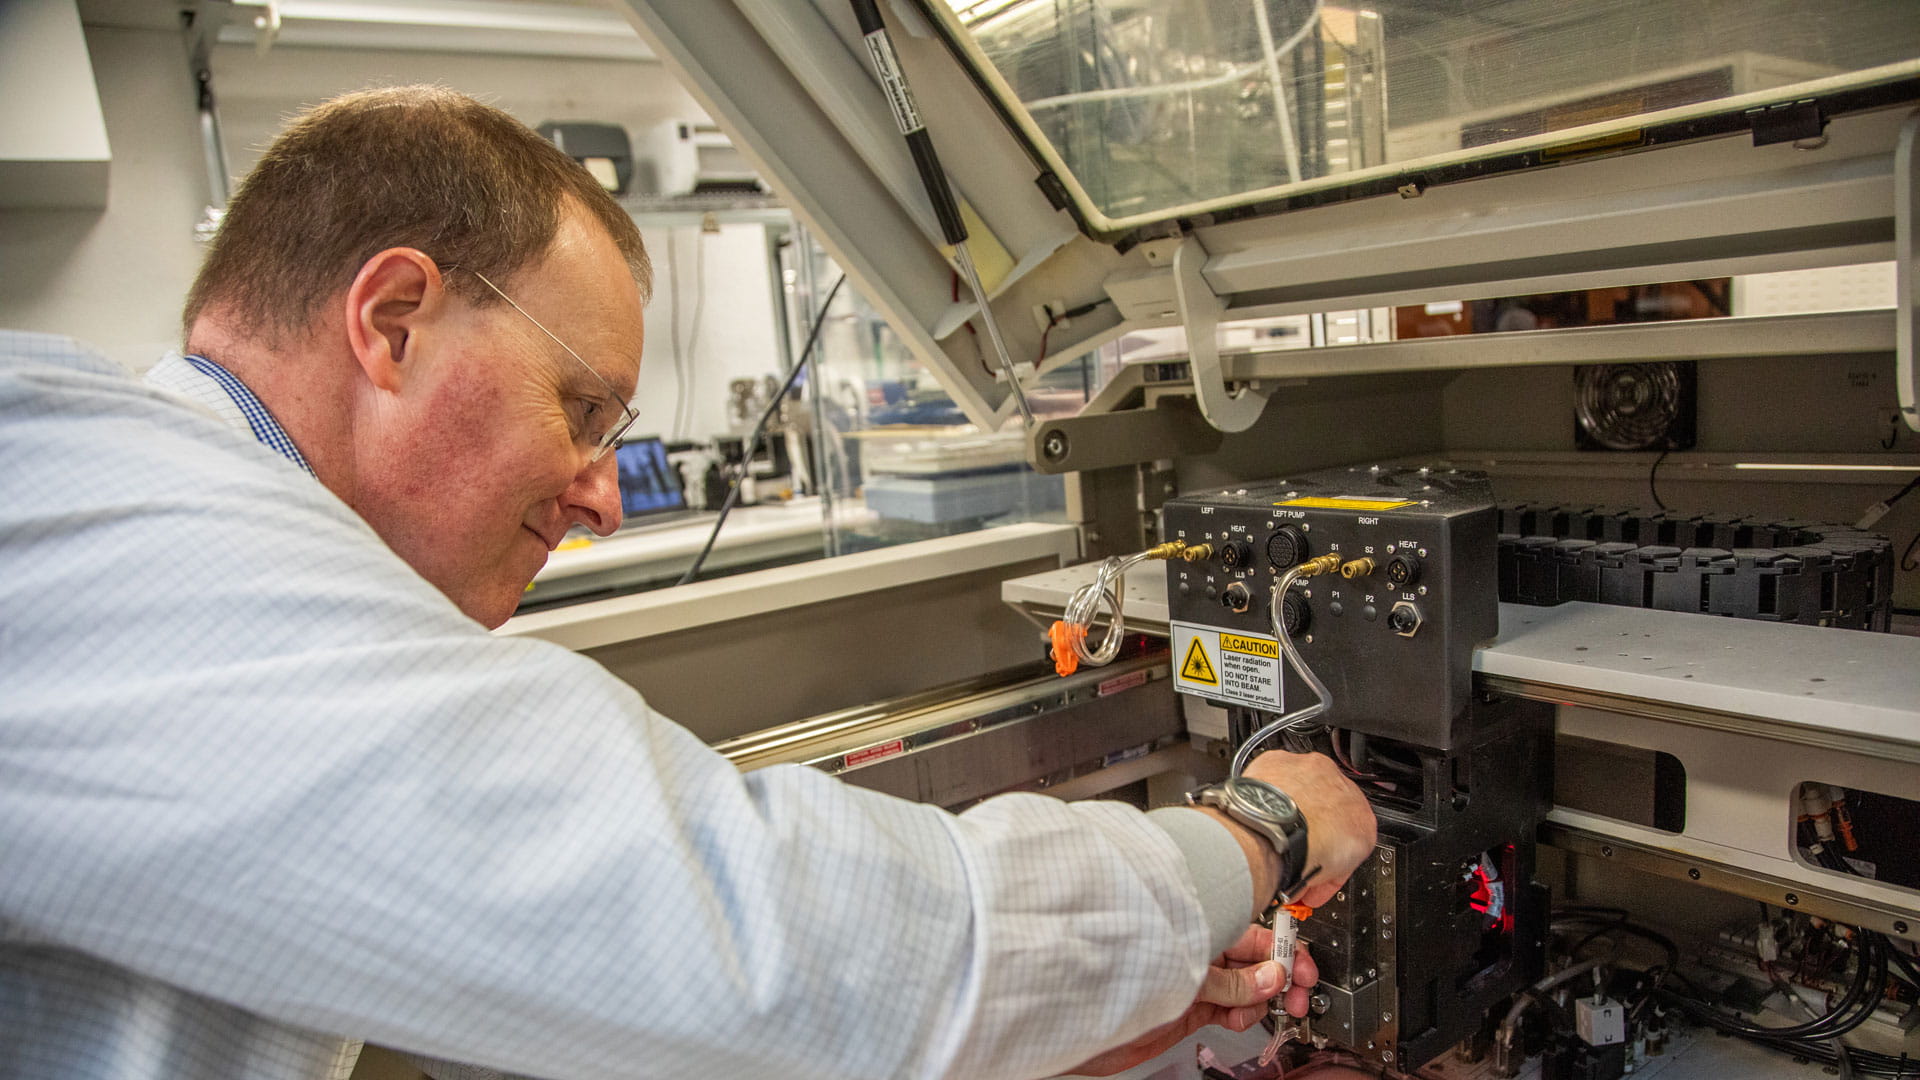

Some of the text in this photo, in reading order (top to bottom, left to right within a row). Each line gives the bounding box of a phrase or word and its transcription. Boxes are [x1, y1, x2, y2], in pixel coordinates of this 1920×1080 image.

[1201, 507, 1214, 515] LEFT
[1273, 510, 1306, 519] LEFT PUMP
[1358, 517, 1379, 525] RIGHT
[1231, 525, 1246, 533] HEAT
[1205, 532, 1212, 540] S4
[1399, 540, 1418, 549] HEAT
[1180, 572, 1187, 580] P3
[1207, 575, 1214, 583] P4
[1235, 571, 1246, 579] LLS
[1402, 592, 1415, 600] LLS
[1232, 639, 1276, 655] CAUTION
[1224, 654, 1271, 667] Laser radiation
[1224, 662, 1260, 673] when open.
[1235, 672, 1249, 681] NOT
[1250, 674, 1271, 685] STARE
[1225, 680, 1261, 692] INTO BEAM.
[1225, 688, 1238, 696] Class
